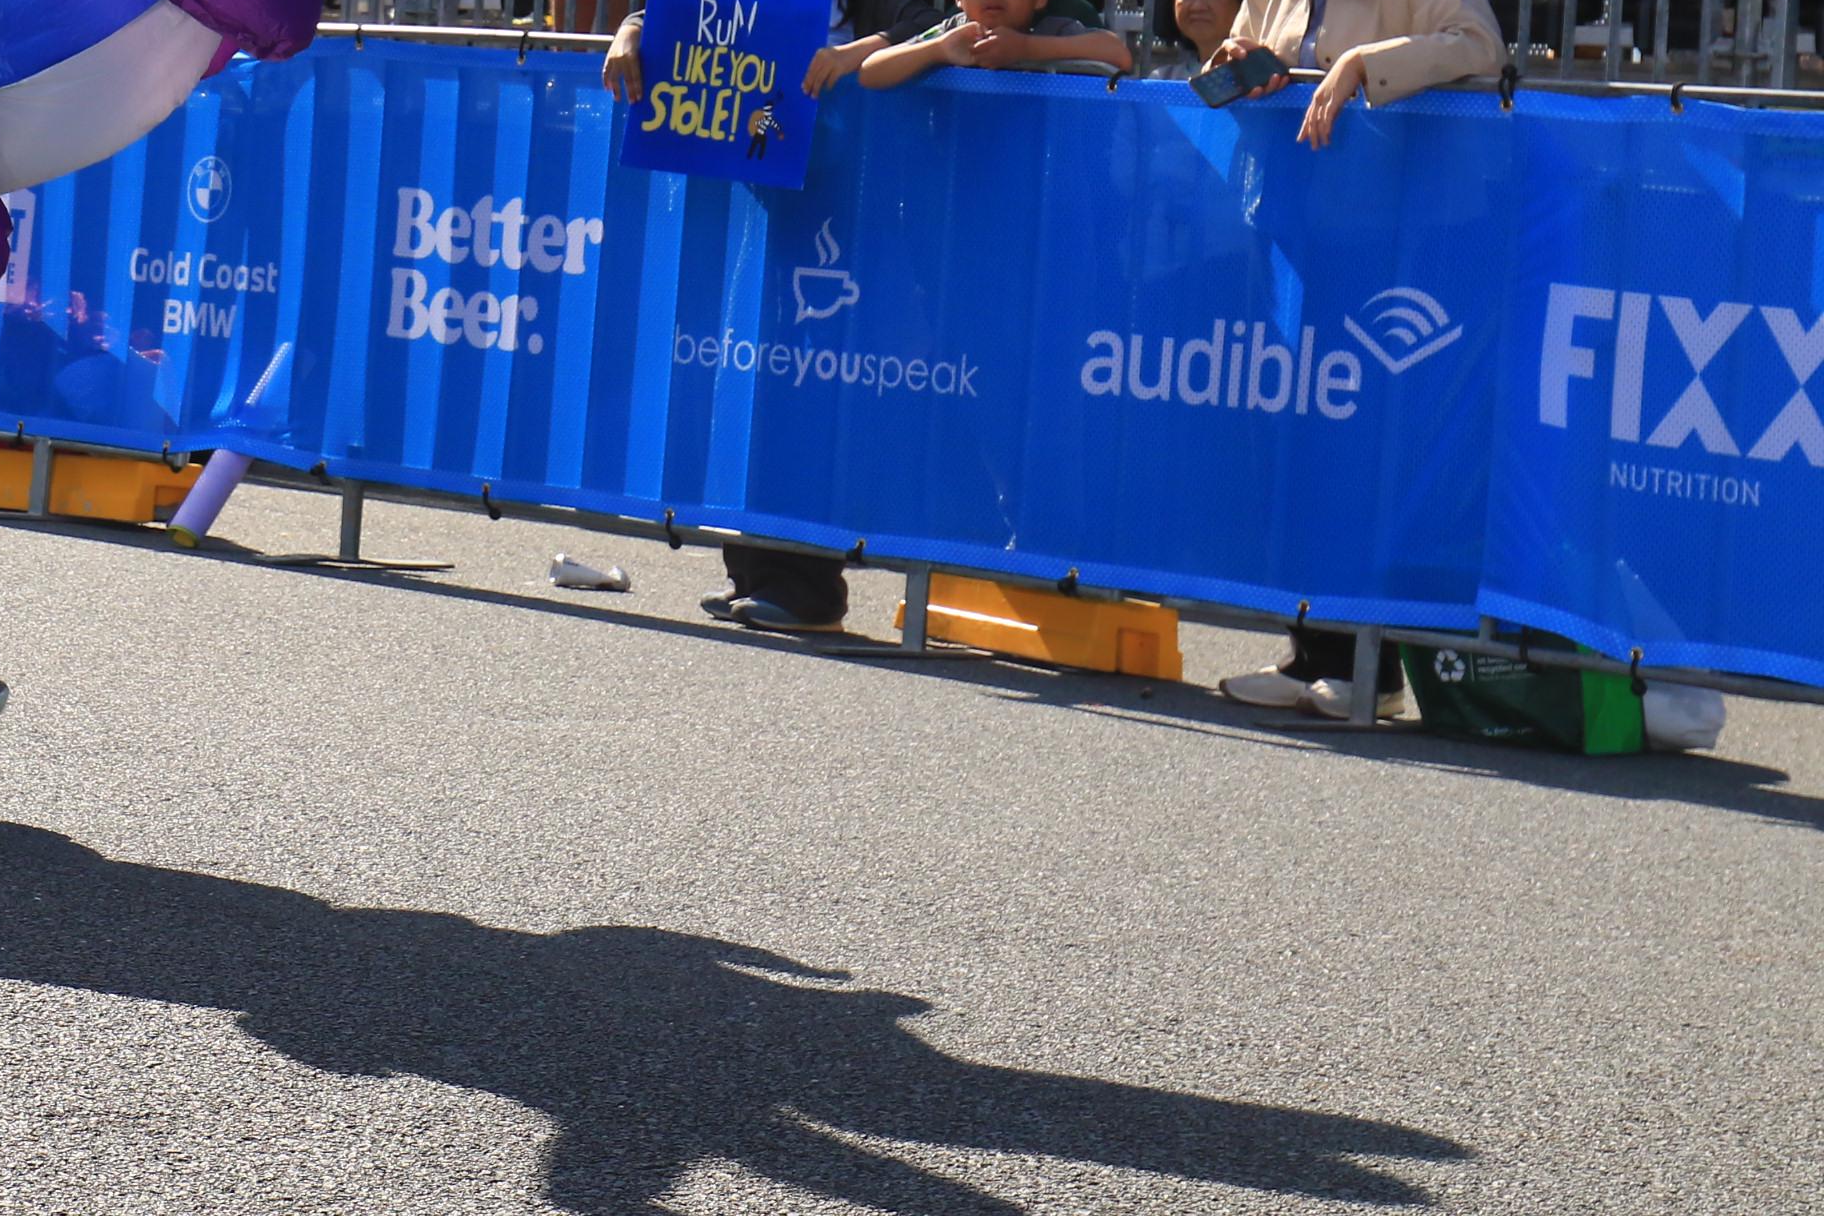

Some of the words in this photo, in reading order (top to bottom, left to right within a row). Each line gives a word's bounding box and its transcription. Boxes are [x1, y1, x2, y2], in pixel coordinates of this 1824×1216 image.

[673, 41, 728, 87] LIKE
[730, 49, 776, 94] YOU
[392, 186, 605, 275] Better
[129, 247, 192, 287] Gold
[198, 253, 279, 294] Coast
[162, 298, 238, 339] BMW
[386, 266, 544, 355] Beer.
[674, 324, 979, 397] beforeyouspeak
[1080, 317, 1363, 421] audible
[1539, 282, 1824, 469] FIXX
[1609, 460, 1761, 508] NUTRITION
